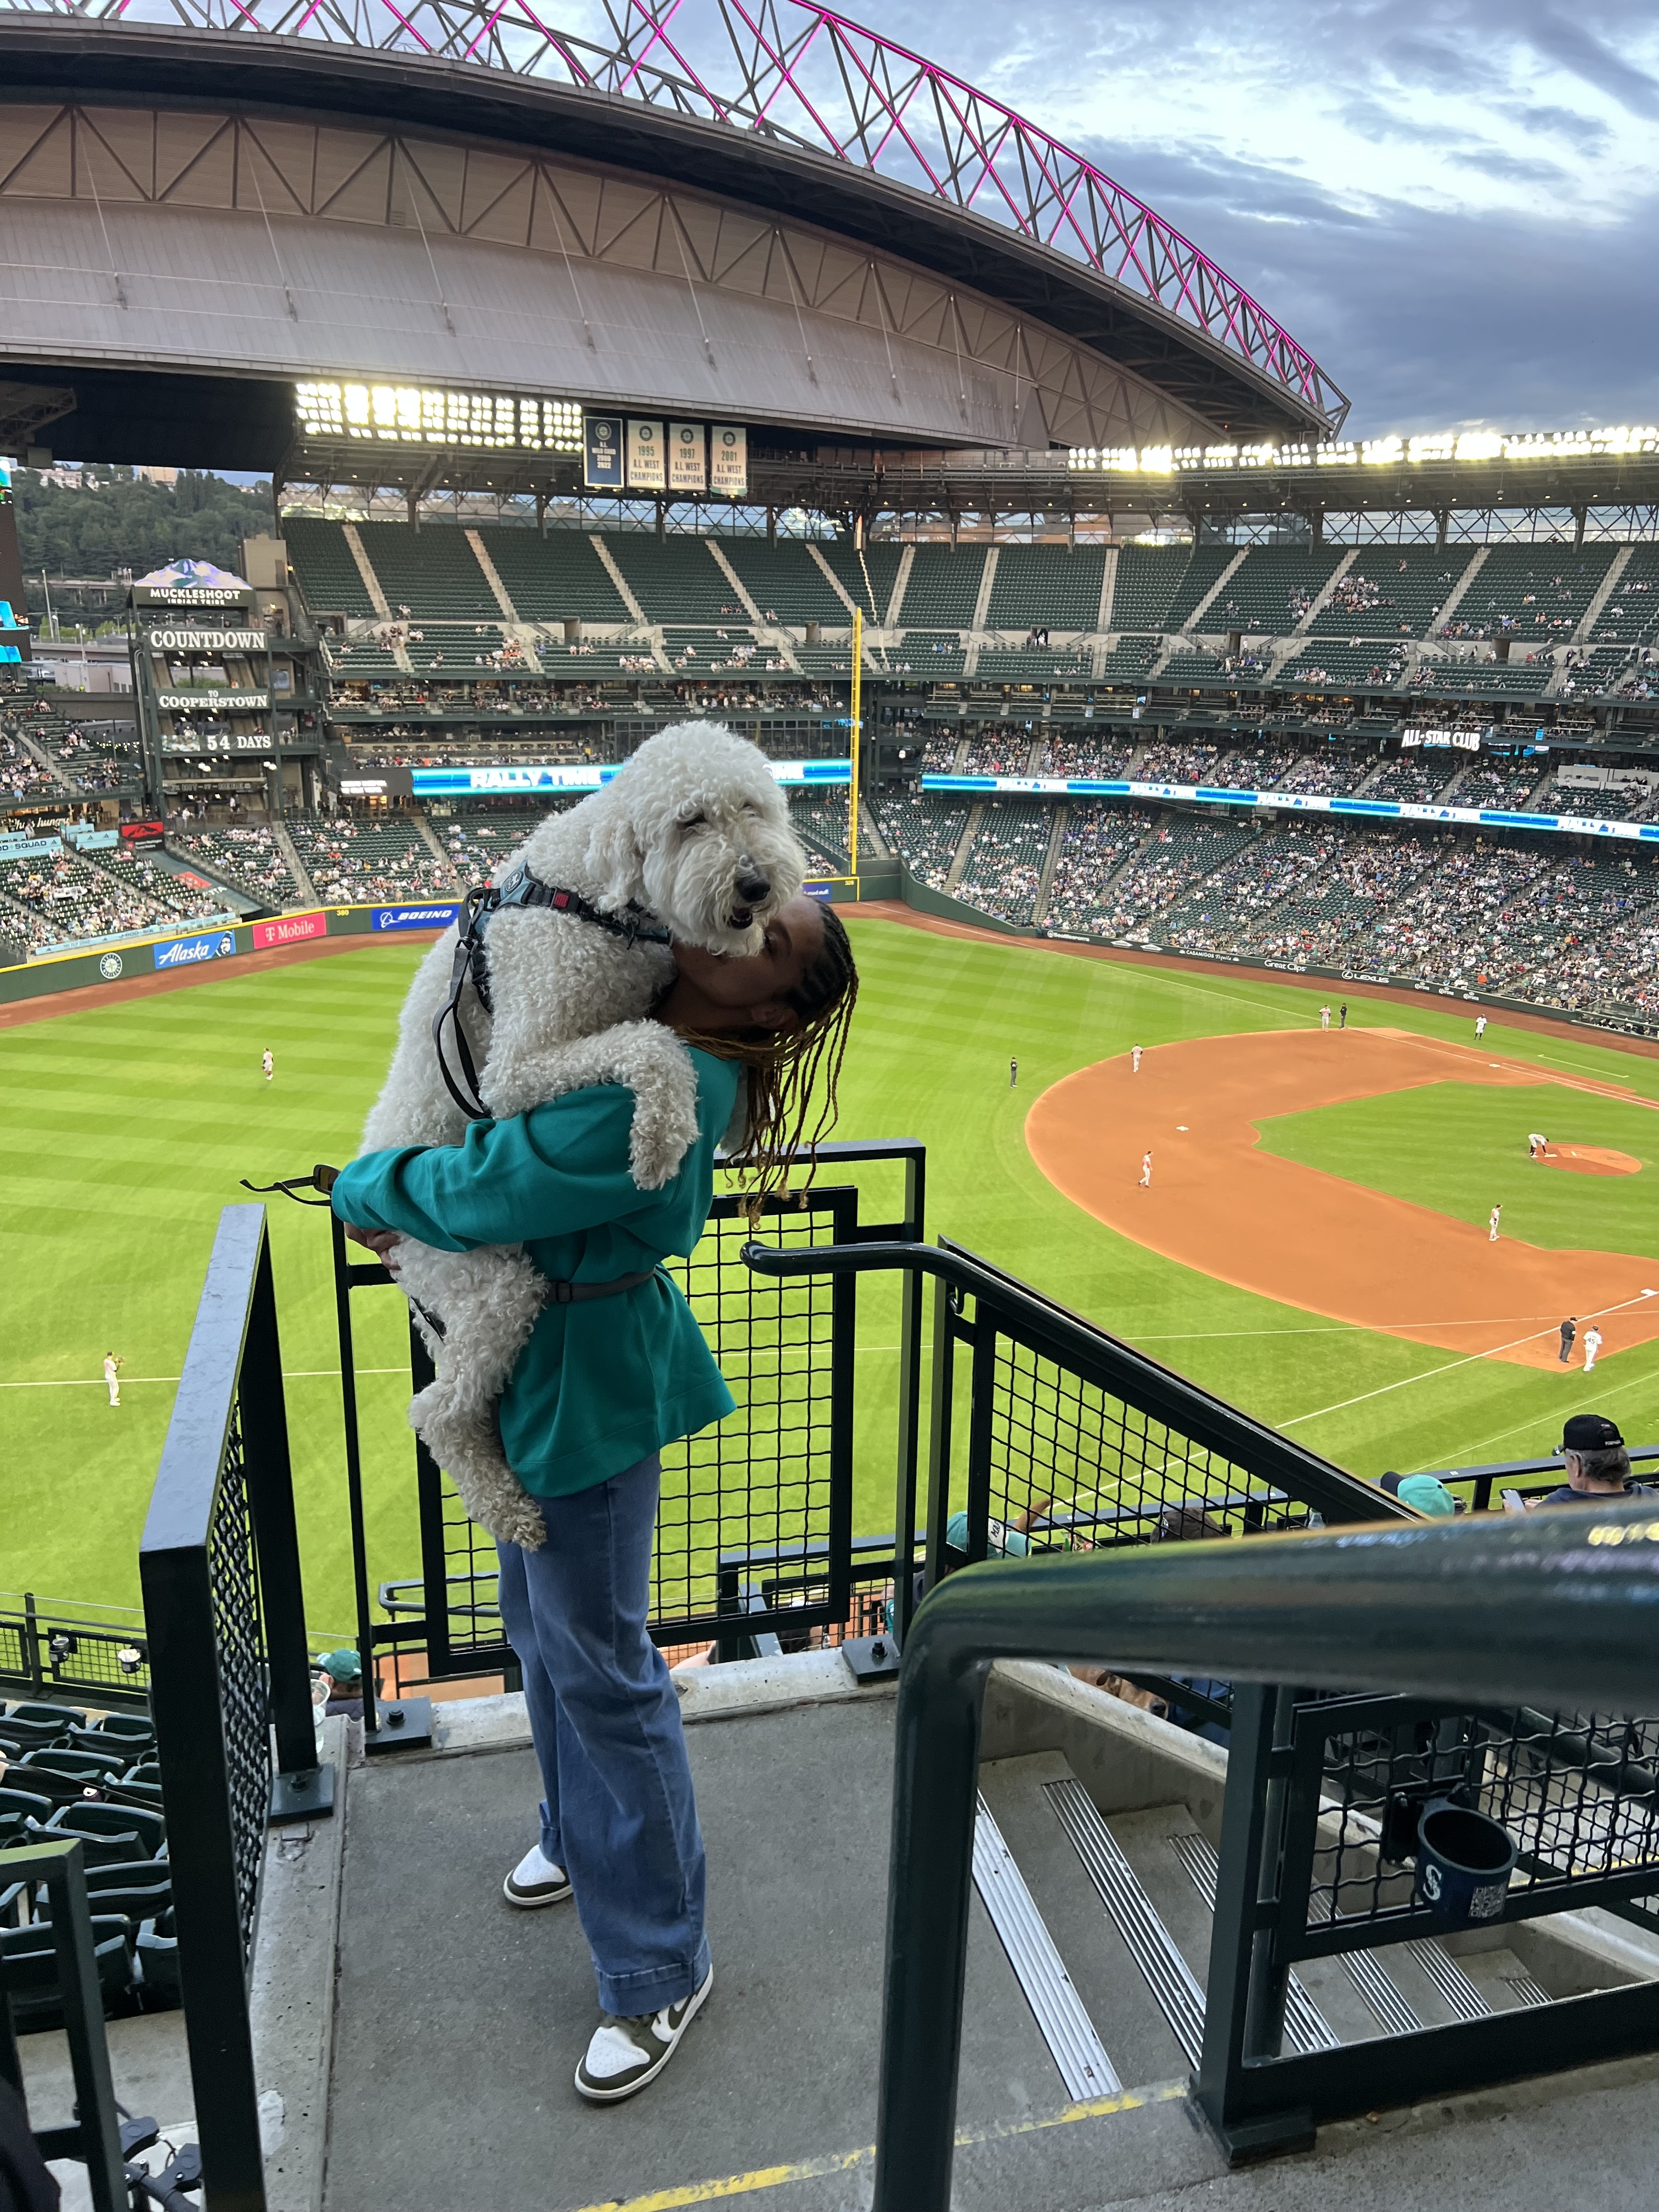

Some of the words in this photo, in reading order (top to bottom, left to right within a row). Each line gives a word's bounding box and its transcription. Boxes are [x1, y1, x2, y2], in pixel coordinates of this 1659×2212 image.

[638, 445, 654, 456] 1995
[680, 448, 695, 459] 1997
[721, 450, 737, 461] 2001
[644, 460, 659, 469] WEST
[685, 462, 700, 471] WEST
[727, 465, 741, 473] WEST
[630, 471, 663, 481] CHAMPIONS
[672, 473, 703, 483] CHAMPIONS
[714, 476, 744, 486] CHAMPIONS
[150, 588, 240, 600] MUCKLESHOOT
[150, 630, 265, 648] COUNTDOWN
[159, 695, 267, 708] COOPERSTOWN
[207, 735, 230, 751] 54
[236, 736, 272, 749] DAYS
[1452, 731, 1480, 751] CLUB
[470, 769, 540, 788] RALLY
[546, 768, 601, 786] TIME
[15, 840, 47, 849] SQUAD
[397, 910, 452, 921] BOEING
[278, 920, 314, 940] Mobile
[159, 940, 210, 965] Alaska
[1264, 960, 1286, 969] Great
[1288, 962, 1306, 972] Clips
[1354, 973, 1390, 984] LEXUS
